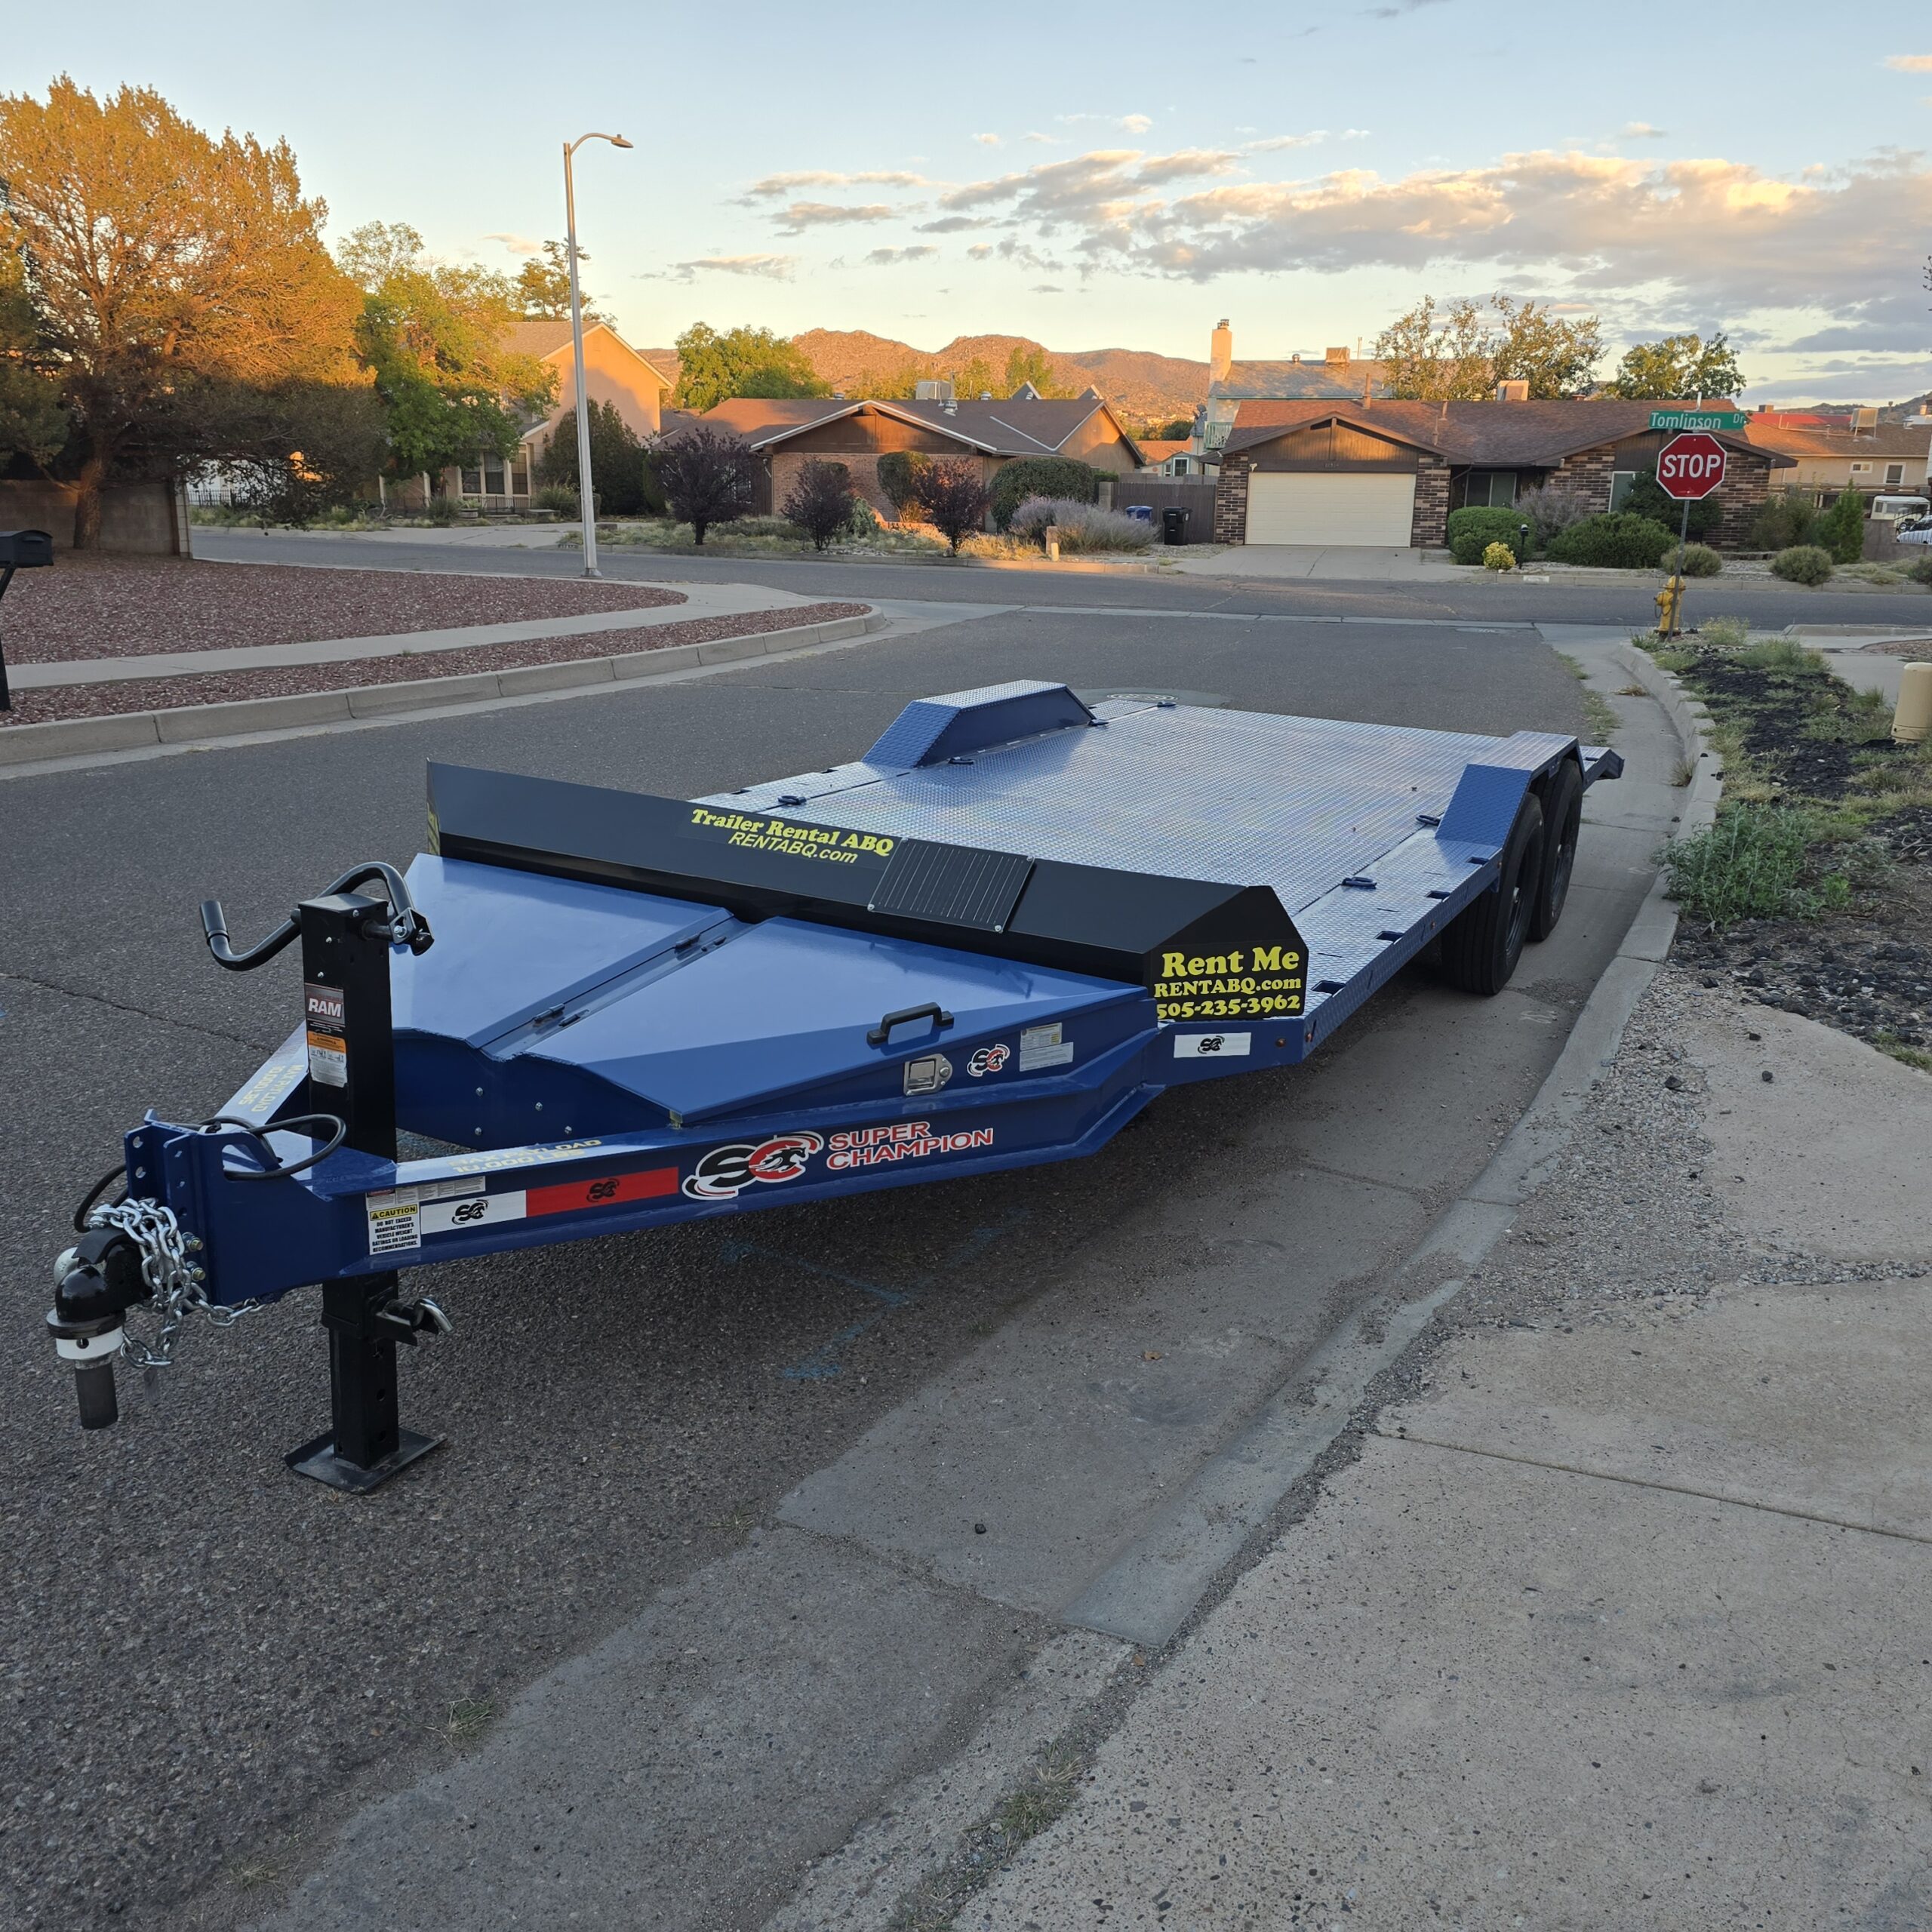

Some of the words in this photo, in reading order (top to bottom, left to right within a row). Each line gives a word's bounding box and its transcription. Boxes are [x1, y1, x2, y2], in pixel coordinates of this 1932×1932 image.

[1651, 413, 1721, 429] Tomlinson
[1733, 414, 1745, 423] Dr
[1662, 454, 1721, 478] STOP
[692, 808, 764, 832] Trailer
[765, 821, 836, 845] Rental
[841, 836, 894, 857] ABQ
[728, 832, 858, 864] RENTABQ.com
[1161, 950, 1244, 978] Rent
[1251, 946, 1300, 971] Me
[1154, 977, 1302, 998] RENTABQ.com
[308, 998, 342, 1017] RAM
[1156, 995, 1300, 1020] 505-235-3962
[829, 1121, 931, 1150] SUPER
[503, 1139, 602, 1158] PAYLOAD
[826, 1128, 993, 1170] CHAMPION
[379, 1207, 416, 1217] CAUTION
